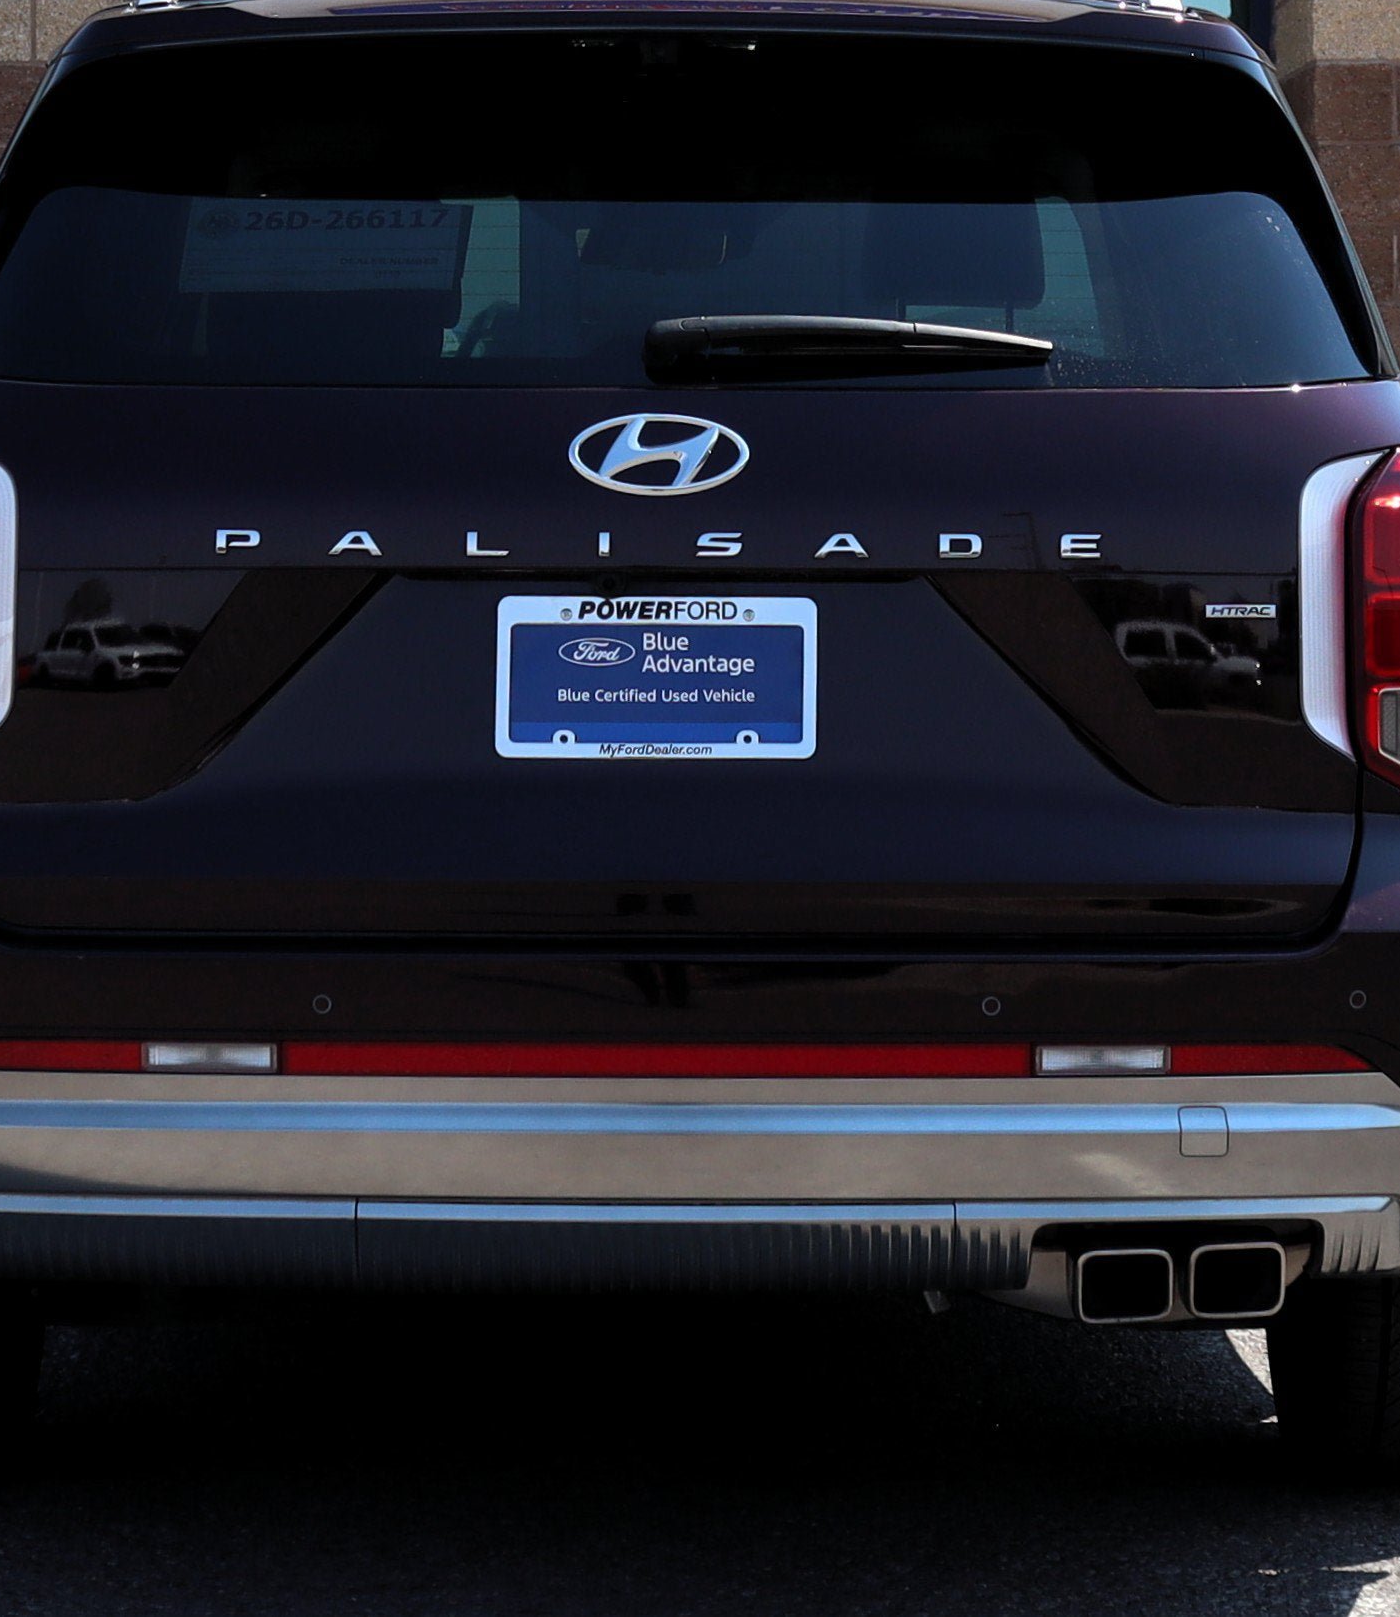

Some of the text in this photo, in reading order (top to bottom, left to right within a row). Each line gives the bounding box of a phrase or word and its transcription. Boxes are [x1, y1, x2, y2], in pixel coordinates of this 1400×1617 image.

[244, 208, 449, 231] 26D-266117
[214, 528, 1103, 560] PALISADE
[578, 600, 738, 620] POWERFORD
[1210, 606, 1272, 617] HTRAC
[572, 641, 620, 662] Ford
[642, 632, 689, 651] Blue
[642, 655, 755, 676] Advantage
[557, 688, 756, 703] Blue Certified Used Vehicle
[598, 743, 712, 757] MyFordDealer.com
